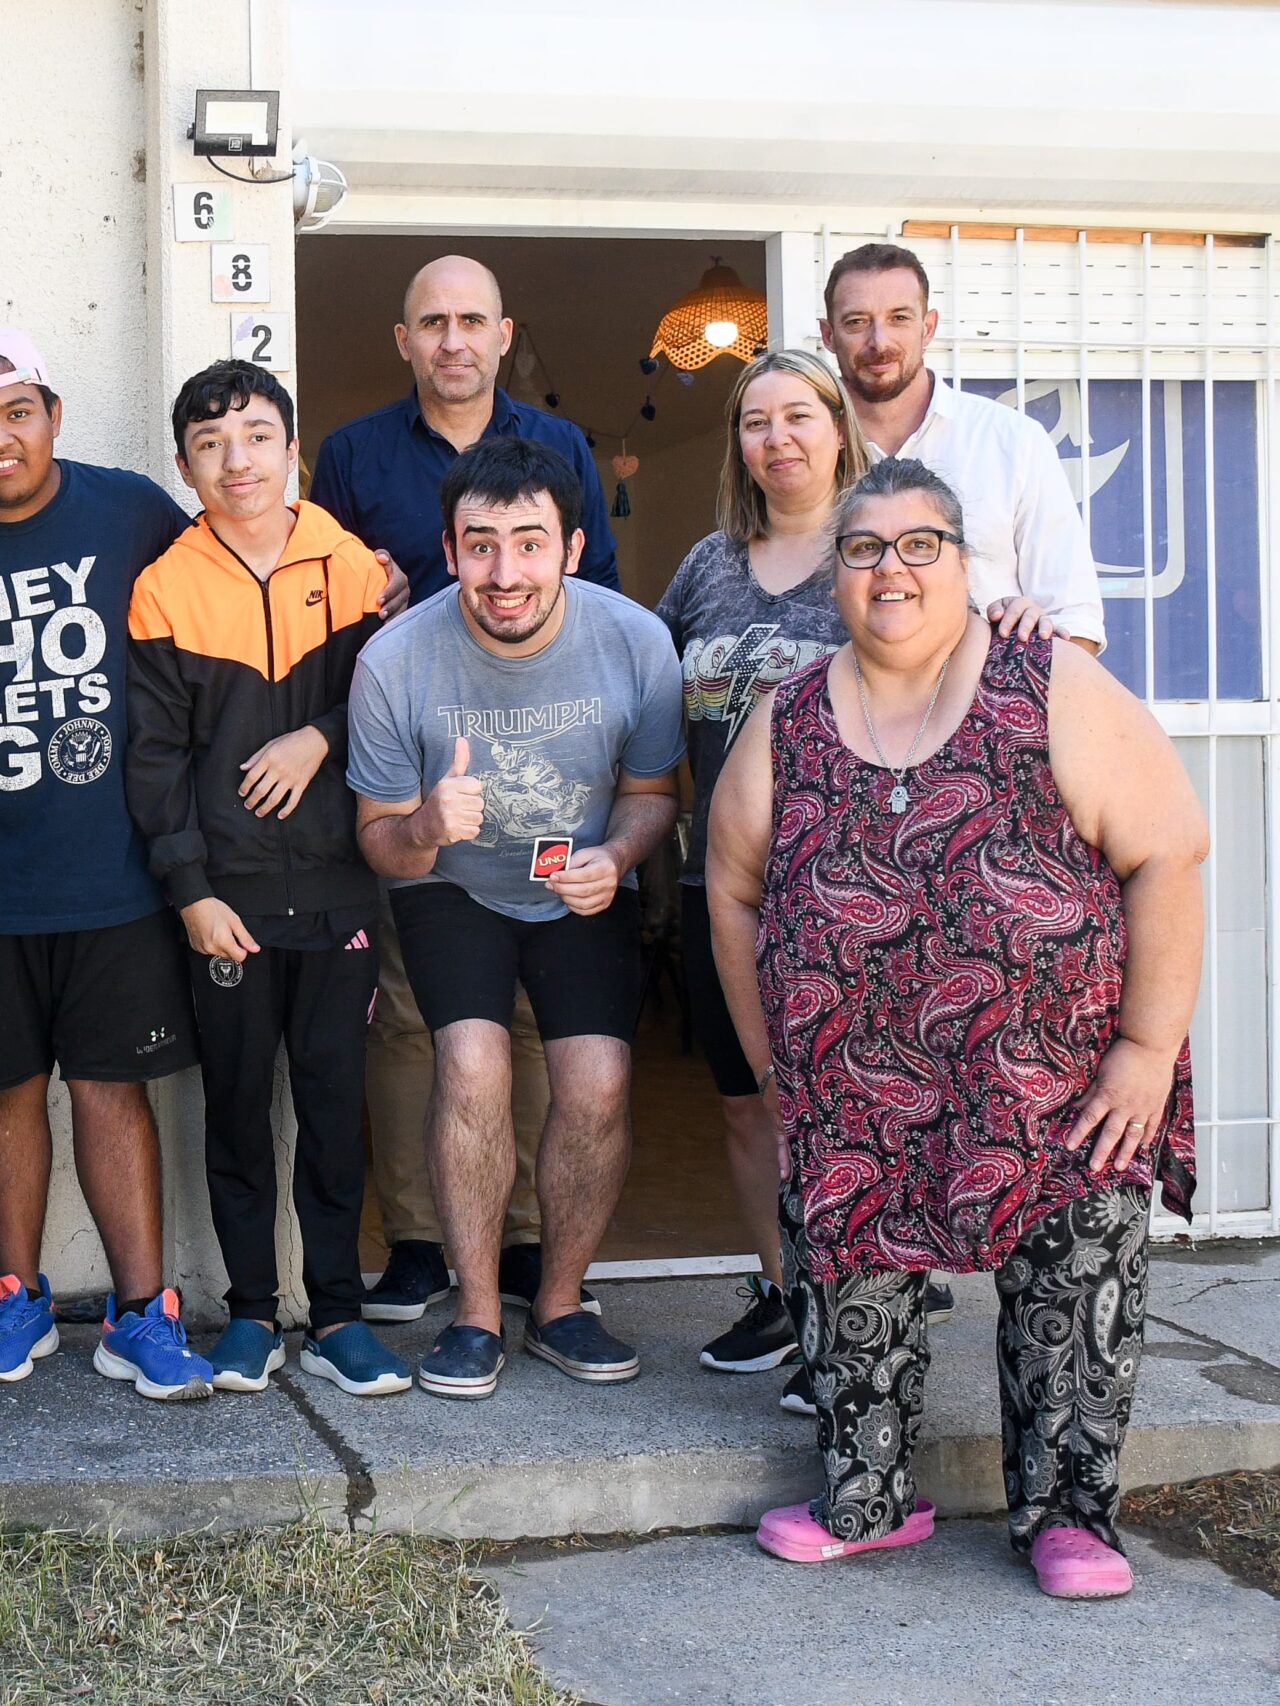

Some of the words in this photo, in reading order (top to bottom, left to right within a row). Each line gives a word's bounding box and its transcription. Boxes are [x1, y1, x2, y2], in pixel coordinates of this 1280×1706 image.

[193, 191, 214, 229] 6
[231, 254, 252, 292] 8
[251, 324, 272, 362] 2
[62, 719, 101, 735] JOHNNY
[437, 697, 602, 739] TRIUMPH
[49, 737, 65, 775] TOMMY
[101, 734, 111, 757] JOEY
[66, 772, 86, 782] DEE
[86, 762, 105, 780] DEE
[538, 854, 567, 867] UNO
